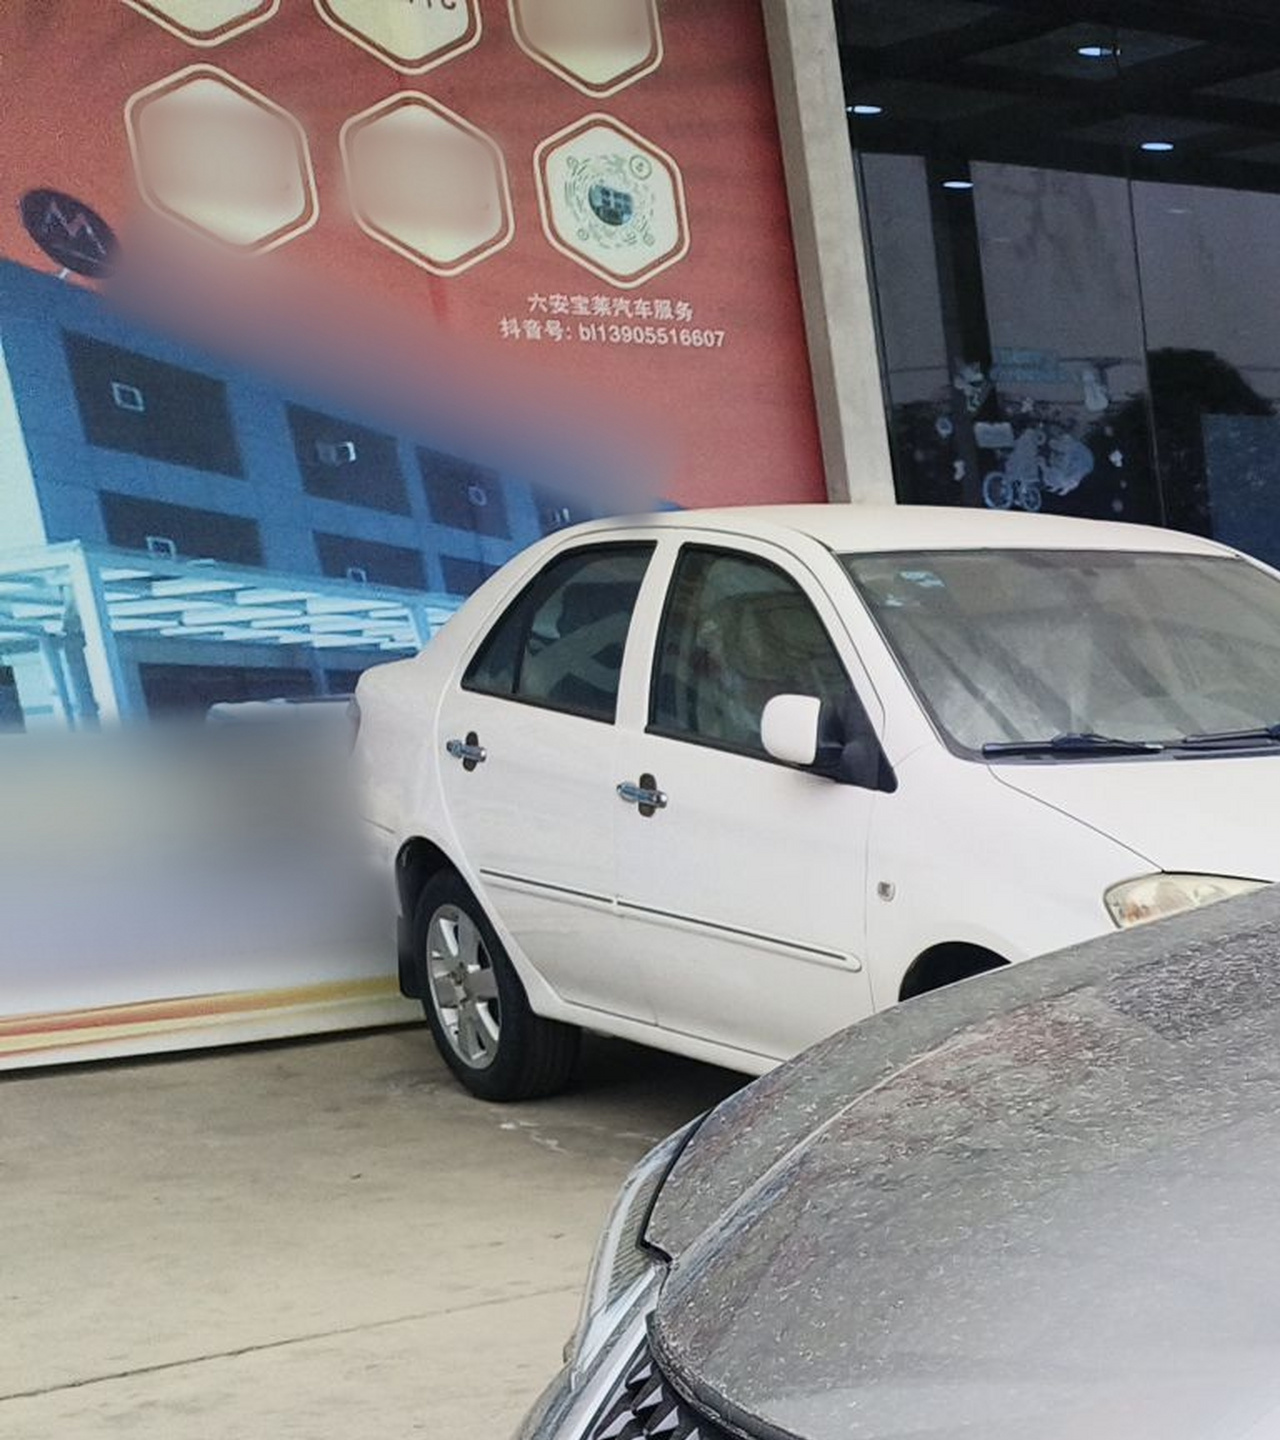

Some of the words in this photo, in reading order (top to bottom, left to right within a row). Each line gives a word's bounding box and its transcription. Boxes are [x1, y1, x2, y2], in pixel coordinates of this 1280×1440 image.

[527, 293, 694, 322] 六安宝莱汽车服务
